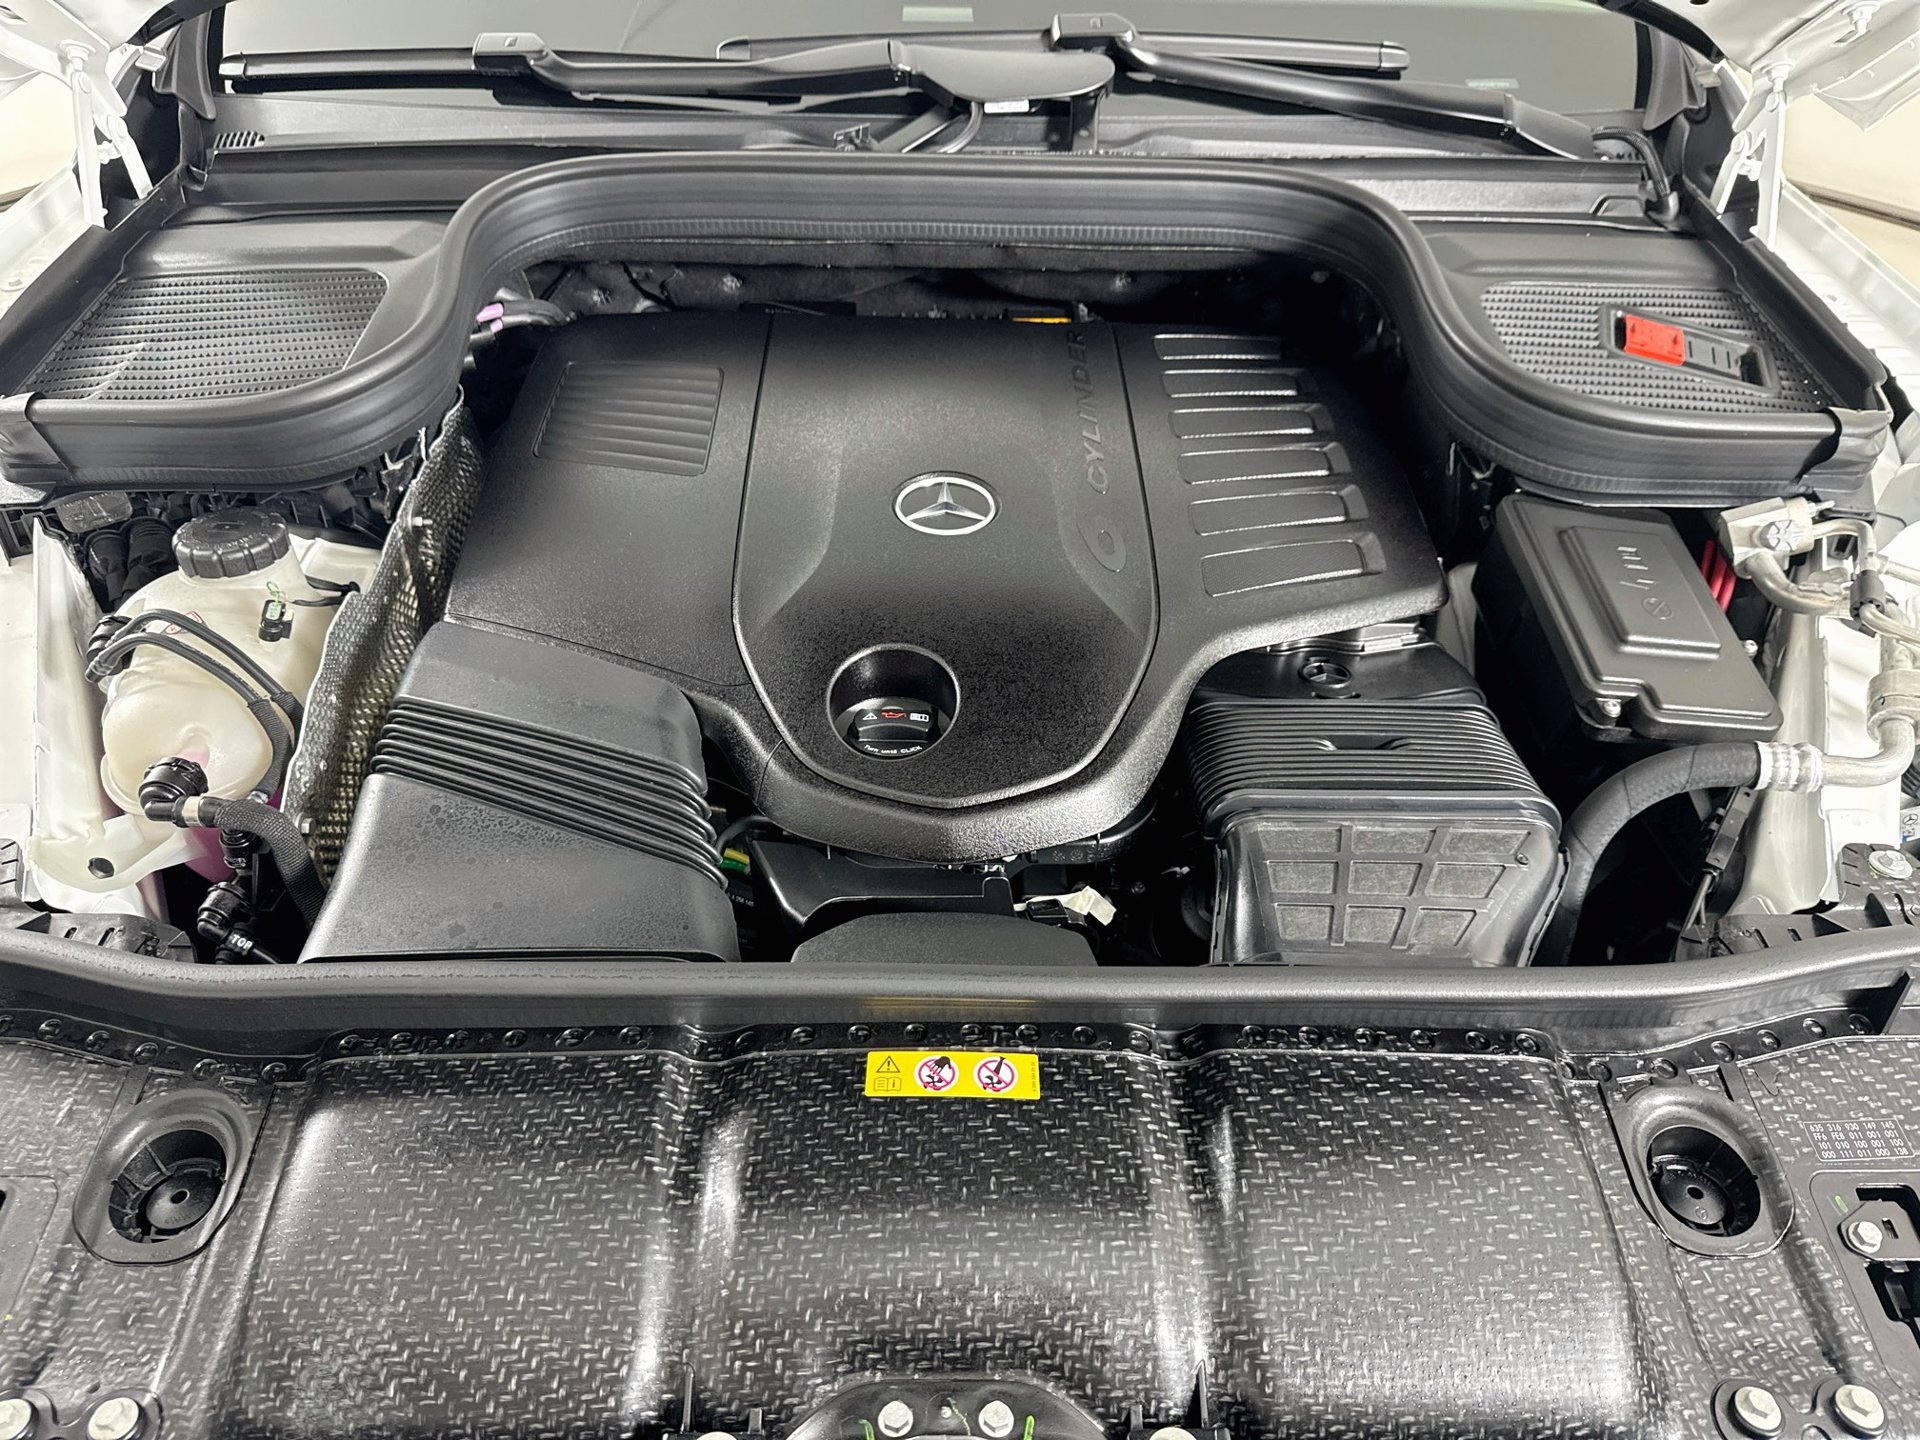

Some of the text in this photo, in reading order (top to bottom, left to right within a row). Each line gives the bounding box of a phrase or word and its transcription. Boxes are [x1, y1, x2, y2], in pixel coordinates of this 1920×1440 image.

[1067, 330, 1110, 495] CYLINDER
[864, 744, 879, 753] Turn
[900, 745, 923, 754] CLICK
[1880, 1120, 1895, 1129] 145
[1814, 1132, 1828, 1141] FF6
[1848, 1132, 1863, 1140] 011
[1866, 1130, 1881, 1139] 001
[1884, 1130, 1899, 1138] 001
[1818, 1142, 1832, 1150] 101
[1854, 1140, 1868, 1149] 100
[1870, 1140, 1886, 1148] 001
[1890, 1138, 1904, 1147] 100
[1822, 1150, 1837, 1159] 000
[1840, 1150, 1854, 1158] 111
[1858, 1150, 1872, 1158] 011
[1876, 1148, 1891, 1157] 000
